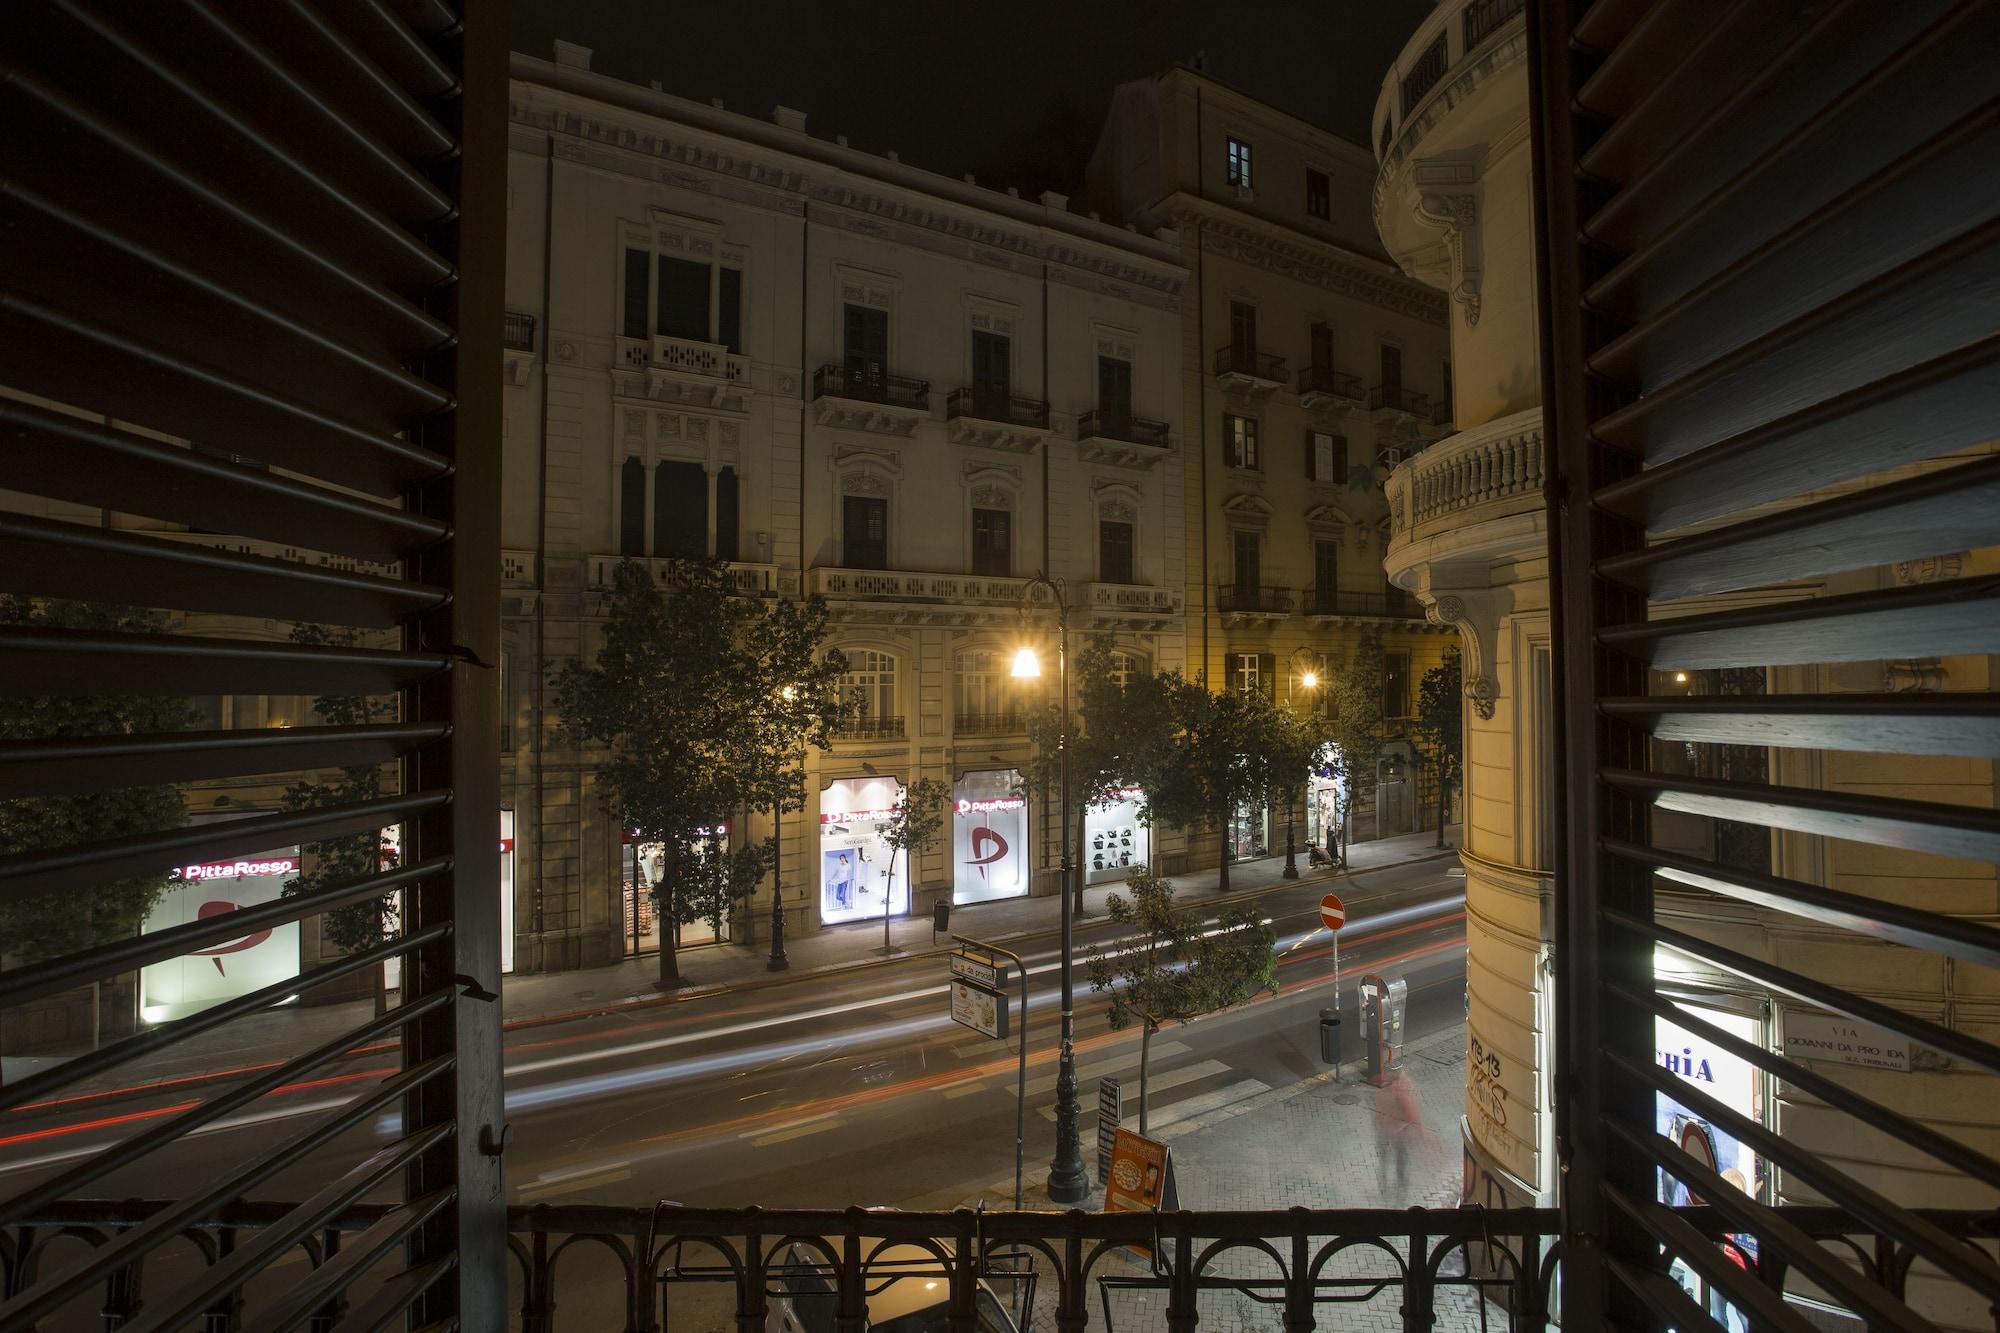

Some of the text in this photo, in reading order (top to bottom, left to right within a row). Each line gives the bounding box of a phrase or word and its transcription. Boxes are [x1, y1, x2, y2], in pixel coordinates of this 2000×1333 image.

[971, 800, 1023, 812] PittaRosso
[185, 861, 292, 879] PittaRosso
[1787, 1037, 1905, 1058] GIOVANNI DA PROIDA
